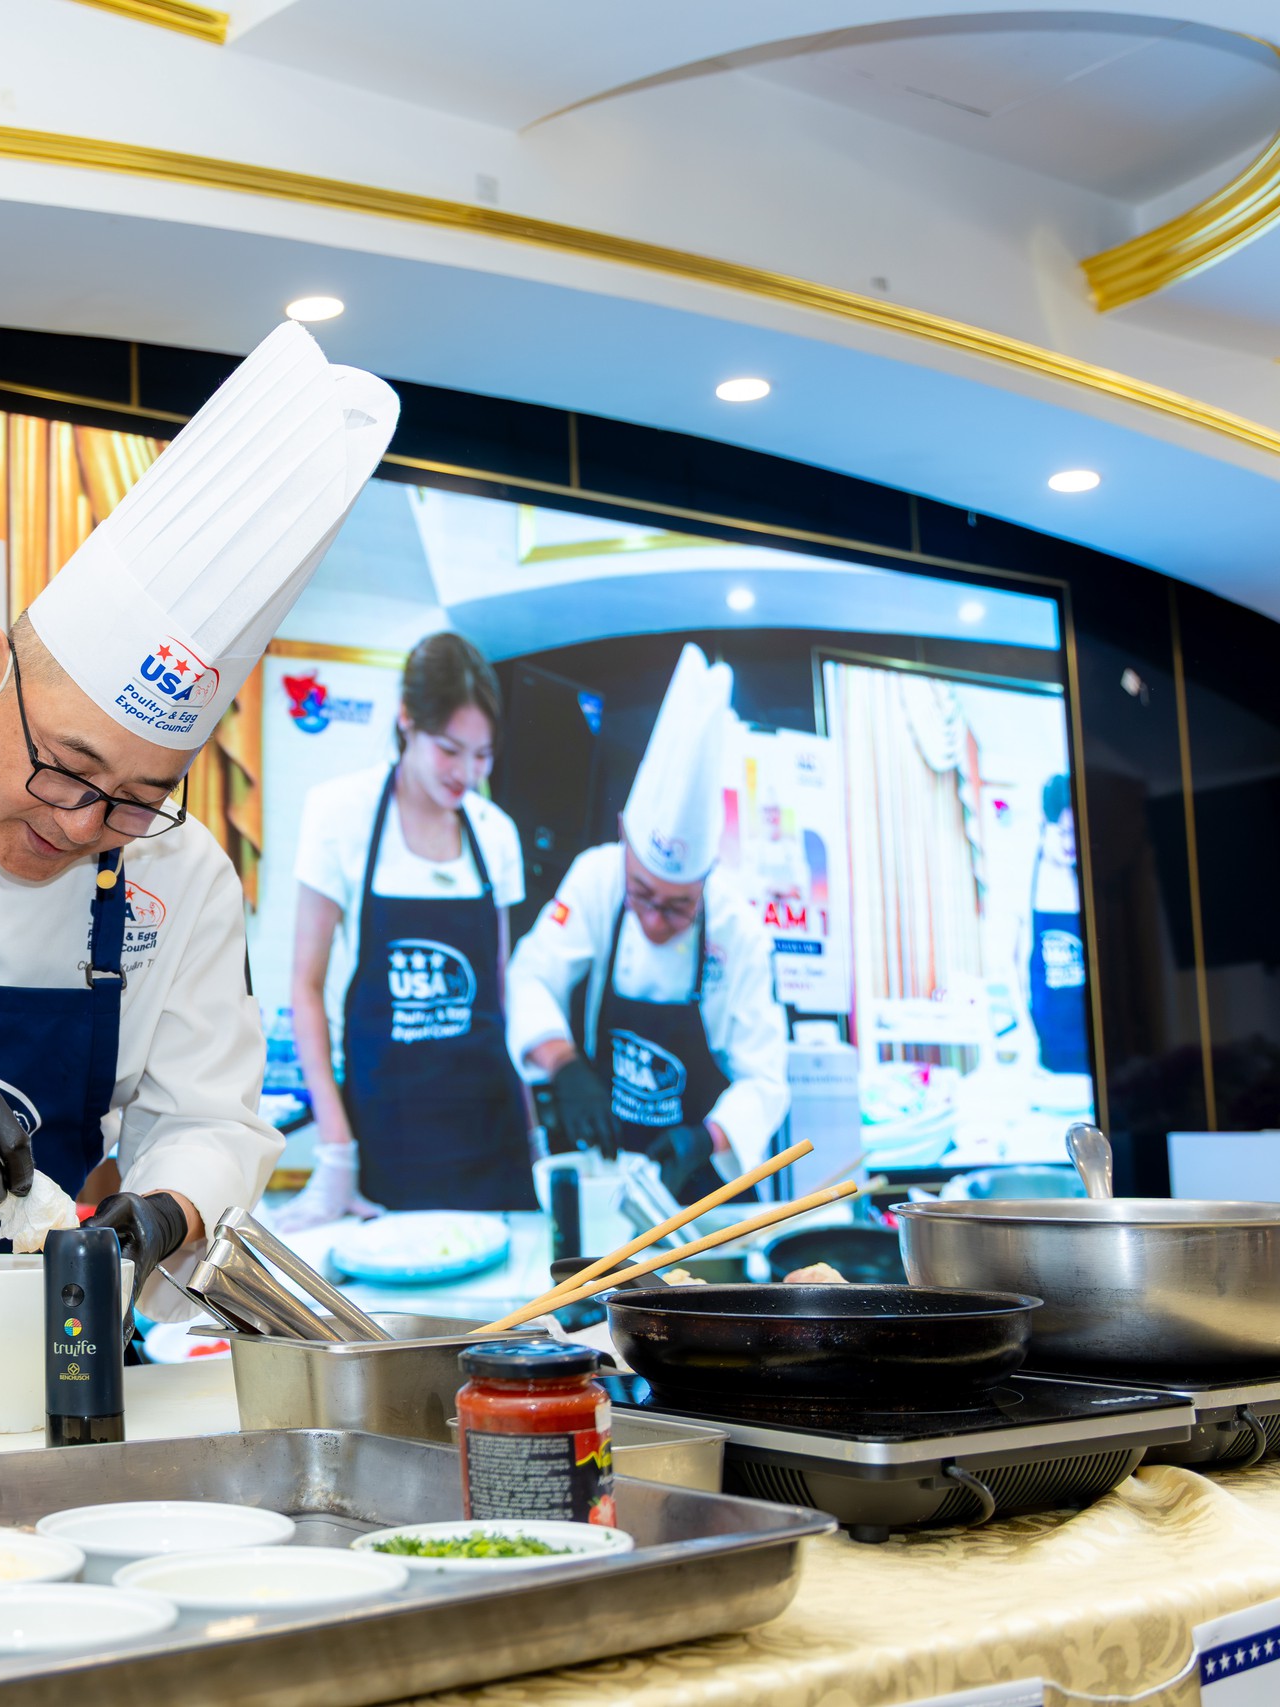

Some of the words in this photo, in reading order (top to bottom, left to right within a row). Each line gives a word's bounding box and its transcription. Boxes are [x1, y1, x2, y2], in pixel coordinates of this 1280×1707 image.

[140, 654, 195, 701] USA
[115, 695, 155, 724] Export
[154, 721, 194, 733] Council
[123, 684, 167, 718] Poultry
[168, 711, 177, 720] &
[178, 711, 198, 723] Egg
[120, 940, 157, 953] Council
[125, 932, 134, 941] &
[137, 931, 158, 943] Egg
[388, 970, 448, 999] USA
